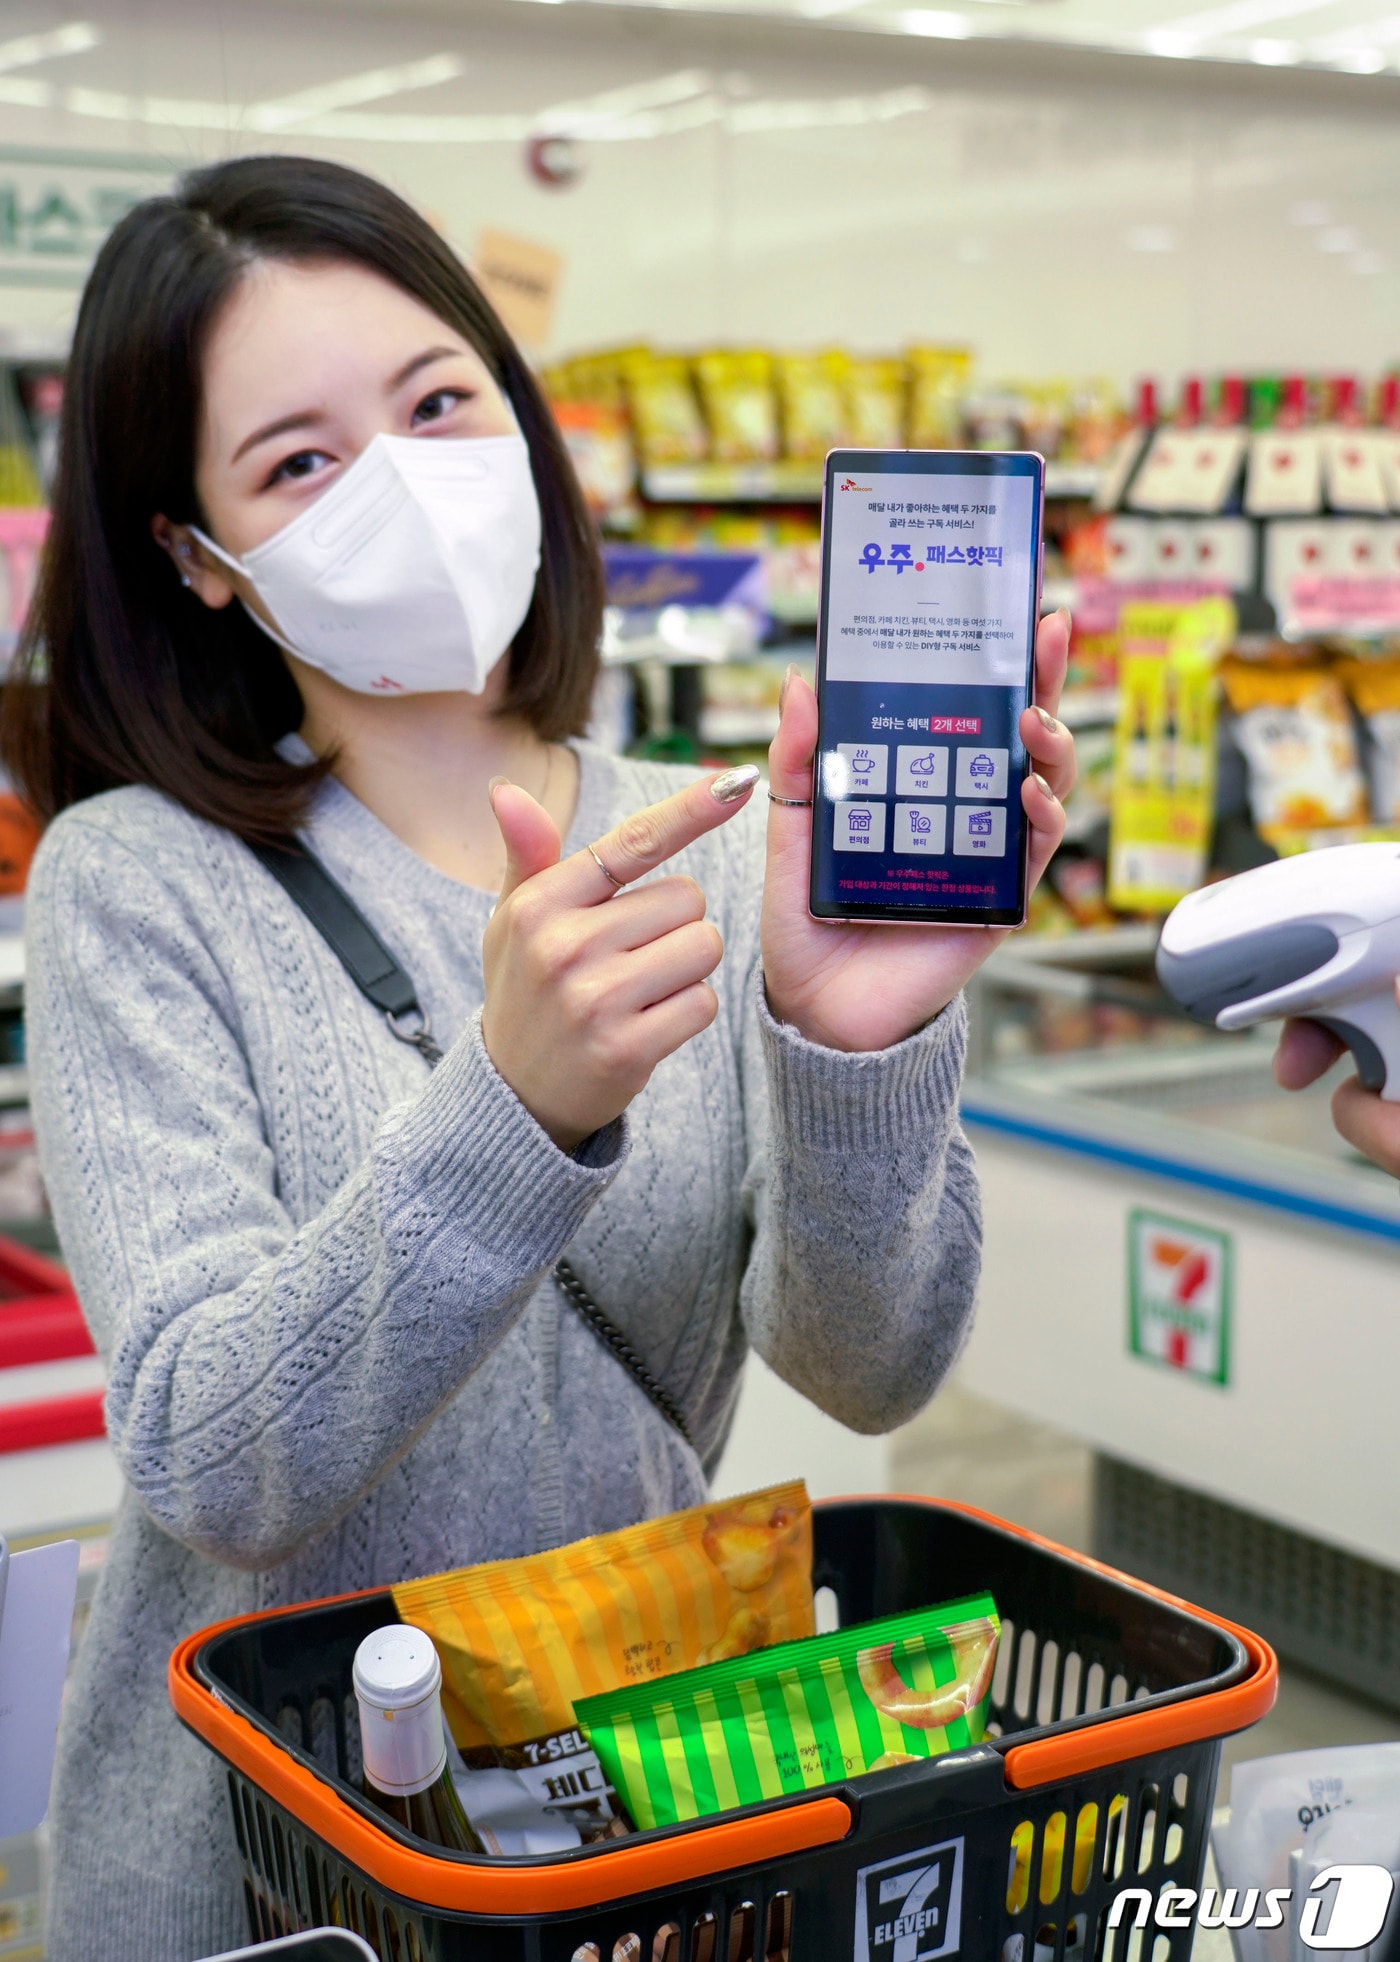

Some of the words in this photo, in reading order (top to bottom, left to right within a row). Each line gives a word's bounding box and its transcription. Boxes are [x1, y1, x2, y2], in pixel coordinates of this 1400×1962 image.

[840, 484, 850, 492] SK
[868, 502, 886, 512] 매달
[887, 502, 904, 512] 내가
[906, 503, 940, 514] 좋아하는
[942, 504, 958, 514] 혜택
[960, 505, 969, 514] 두
[971, 505, 996, 515] 가지를
[889, 518, 906, 528] 골라
[908, 518, 925, 528] 쓰는
[927, 519, 944, 529] 구독
[946, 519, 974, 529] 서비스!
[926, 545, 1002, 567] 패스핫픽
[946, 617, 960, 626] 영화
[962, 618, 970, 626] 등
[971, 618, 986, 627] 여섯
[988, 618, 1002, 627] 가지
[857, 628, 878, 636] 중에서
[880, 628, 895, 637] 매달
[896, 629, 911, 637] 내가
[913, 629, 934, 638] 원하는
[936, 630, 950, 638] 혜택
[952, 630, 959, 638] 두
[961, 630, 982, 639] 가지를
[984, 631, 1014, 640] 선택하여
[873, 641, 894, 649] 이용할
[905, 641, 919, 650] 있는
[921, 642, 941, 651] DIY형
[942, 643, 957, 651] 구독
[959, 643, 981, 651] 서비스
[871, 717, 904, 730] 원하는
[906, 718, 929, 731] 혜택
[934, 719, 952, 731] 2개
[955, 719, 977, 732] 선택
[915, 780, 928, 788] 치킨
[974, 782, 989, 790] 택시
[849, 836, 870, 844] 편의점
[913, 838, 927, 846] 뷰티
[972, 841, 986, 849] 영화
[839, 880, 854, 889] 가입
[855, 880, 877, 889] 대상과
[879, 881, 900, 890] 기간이
[925, 883, 939, 892] 있는
